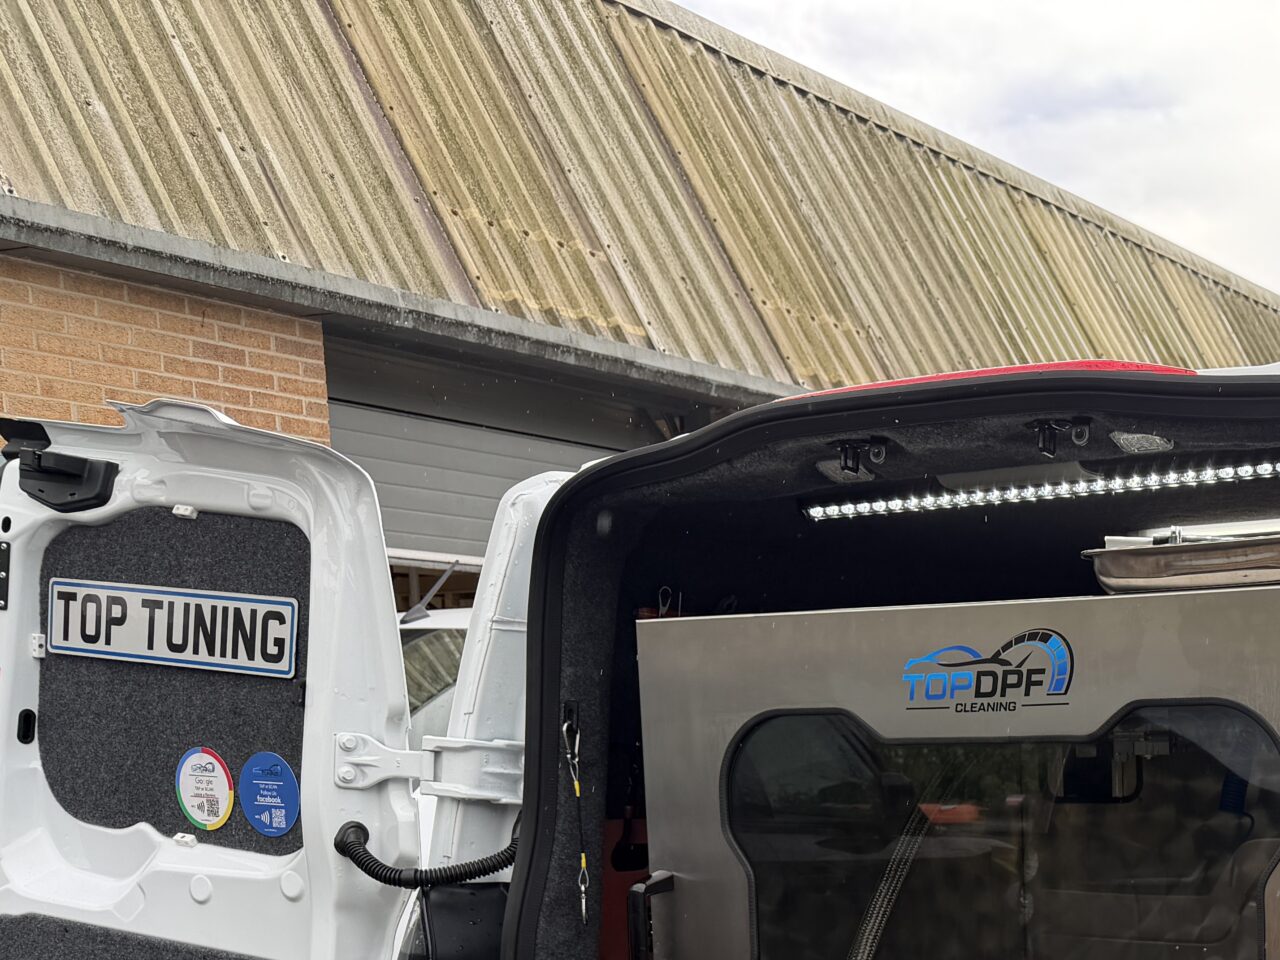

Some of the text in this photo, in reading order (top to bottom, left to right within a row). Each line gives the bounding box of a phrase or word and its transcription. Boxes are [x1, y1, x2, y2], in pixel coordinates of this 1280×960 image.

[57, 591, 287, 664] TOP TUNING
[902, 668, 1047, 701] TOPDPF
[955, 701, 1017, 713] CLEANING
[257, 795, 281, 803] facebook
